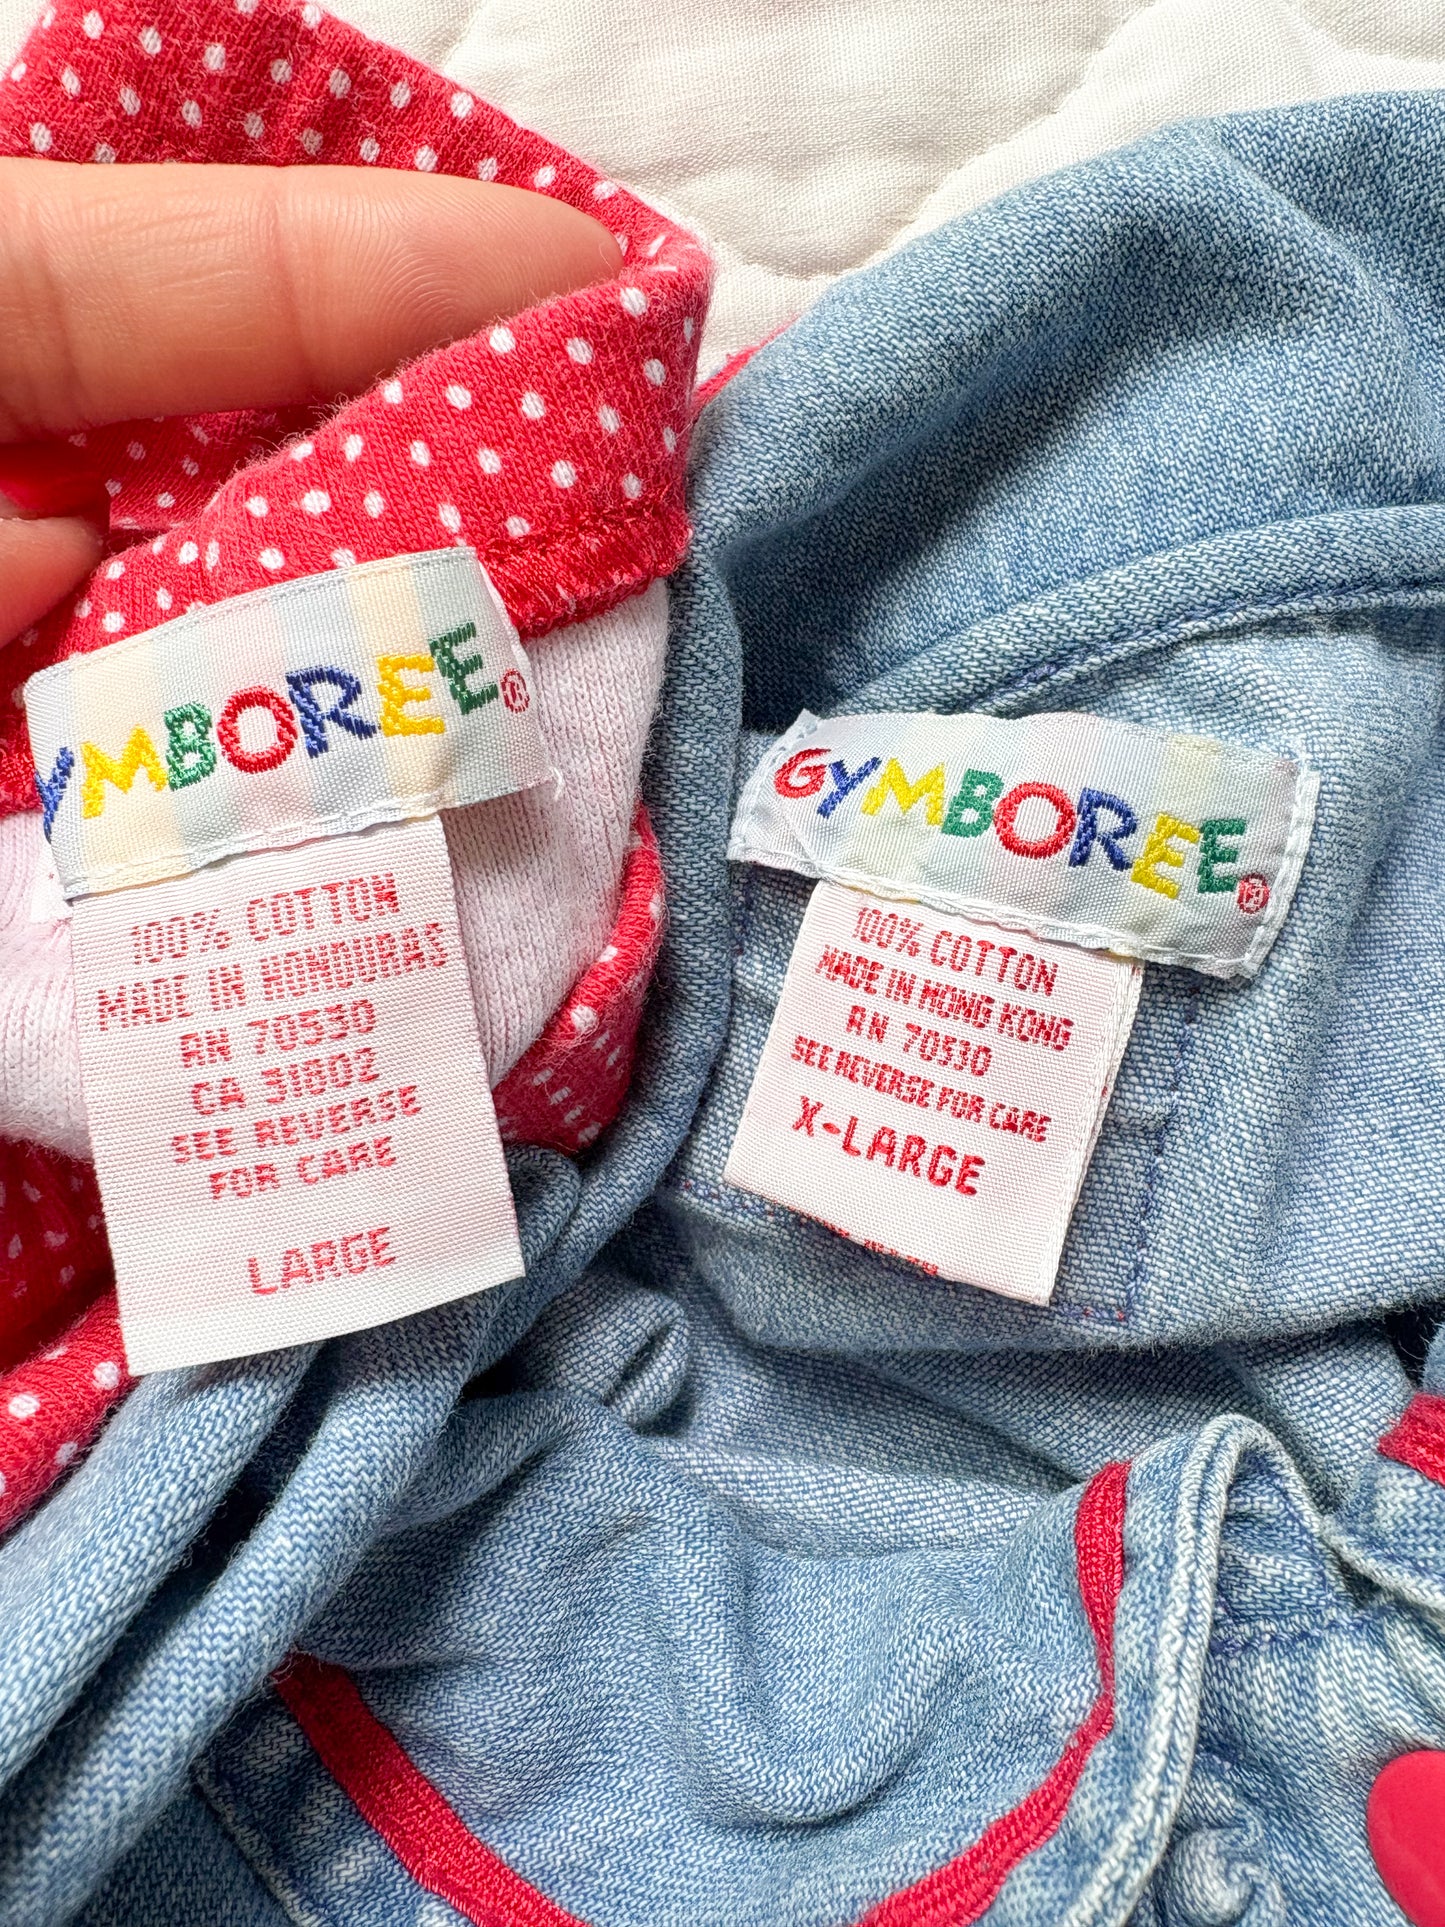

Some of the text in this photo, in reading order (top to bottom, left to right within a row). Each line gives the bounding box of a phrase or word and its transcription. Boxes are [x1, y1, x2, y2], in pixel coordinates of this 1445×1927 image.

[131, 872, 400, 965] 100% COTTON
[852, 907, 1059, 996] 100% COTTON
[98, 922, 448, 1031] MADE IN HONDURAS
[816, 944, 1074, 1050] MADE IN HONG KONG
[180, 998, 376, 1067] RN 70530
[846, 1005, 992, 1076] RN 70530
[172, 1085, 421, 1164] SEE REVERSE
[192, 1078, 246, 1115] CA
[791, 1036, 1052, 1142] SEE REVERSE FOR CARE
[210, 1136, 396, 1200] FOR CARE
[792, 1095, 985, 1195] X-LARGE
[248, 1227, 396, 1295] LARGE
